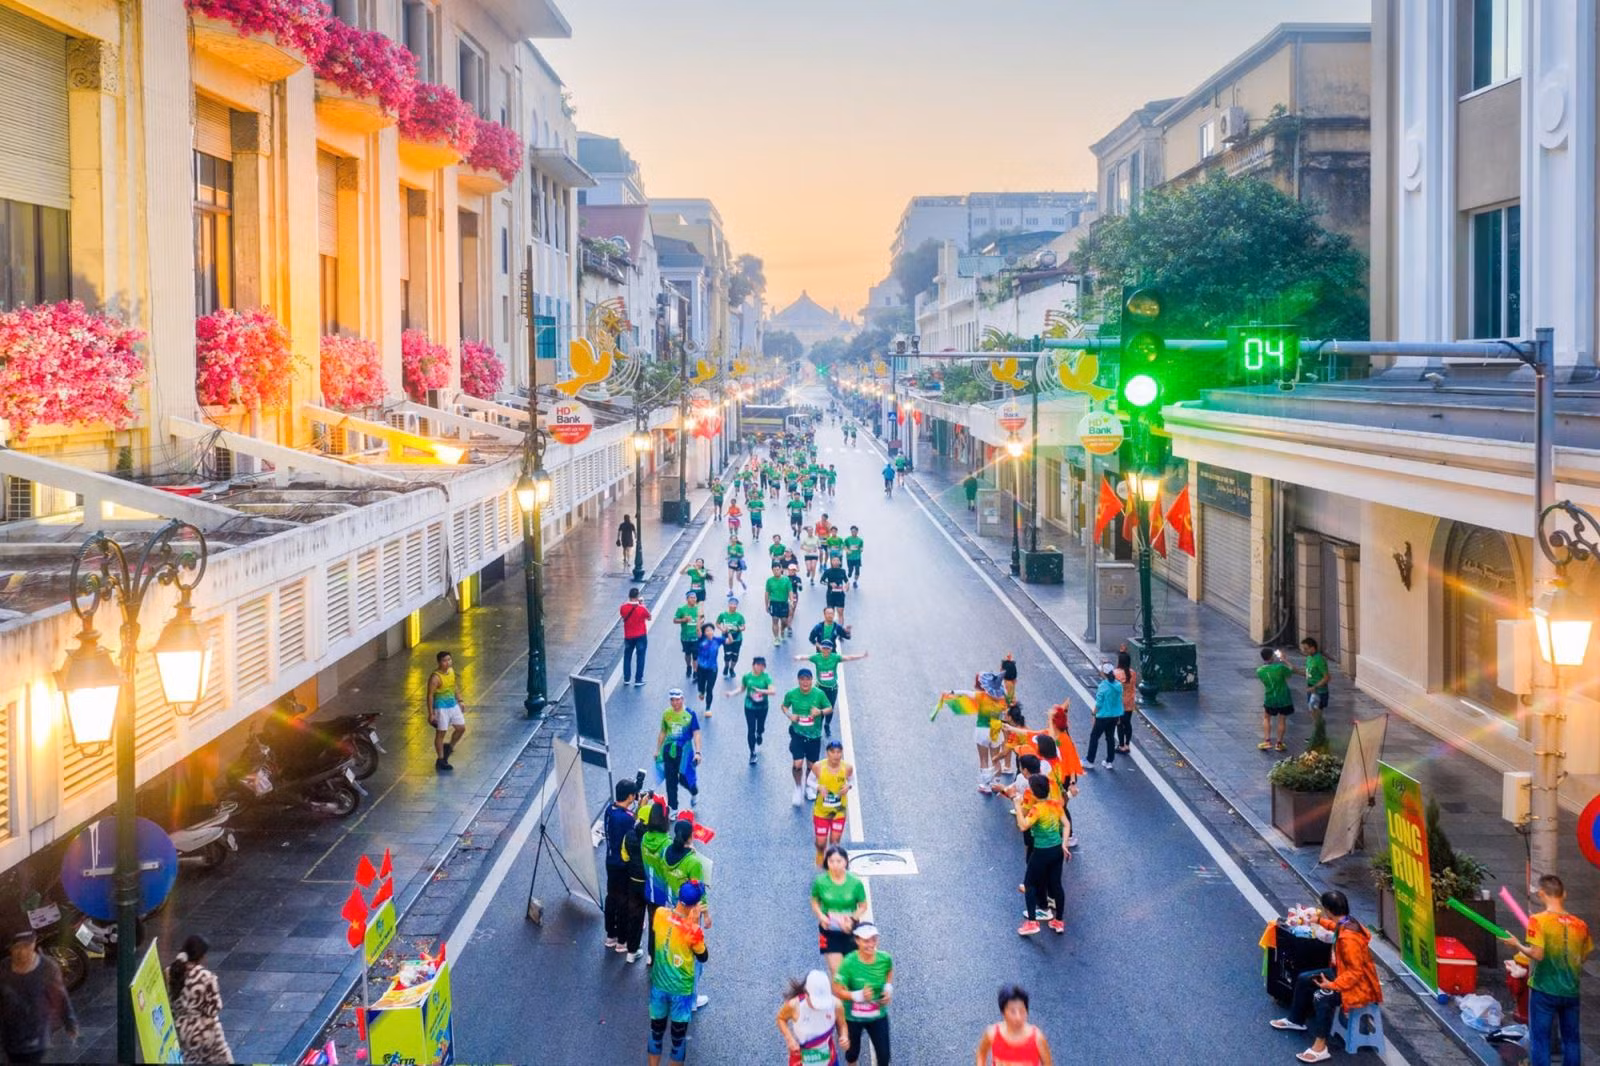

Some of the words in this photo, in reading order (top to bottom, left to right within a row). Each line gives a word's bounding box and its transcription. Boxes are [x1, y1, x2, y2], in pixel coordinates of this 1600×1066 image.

[1244, 337, 1284, 370] 04
[556, 406, 571, 415] HD
[556, 415, 581, 424] Bank
[1088, 419, 1102, 427] HD
[1088, 427, 1112, 435] Bank
[1388, 808, 1423, 857] LONG
[1391, 843, 1425, 897] RUN
